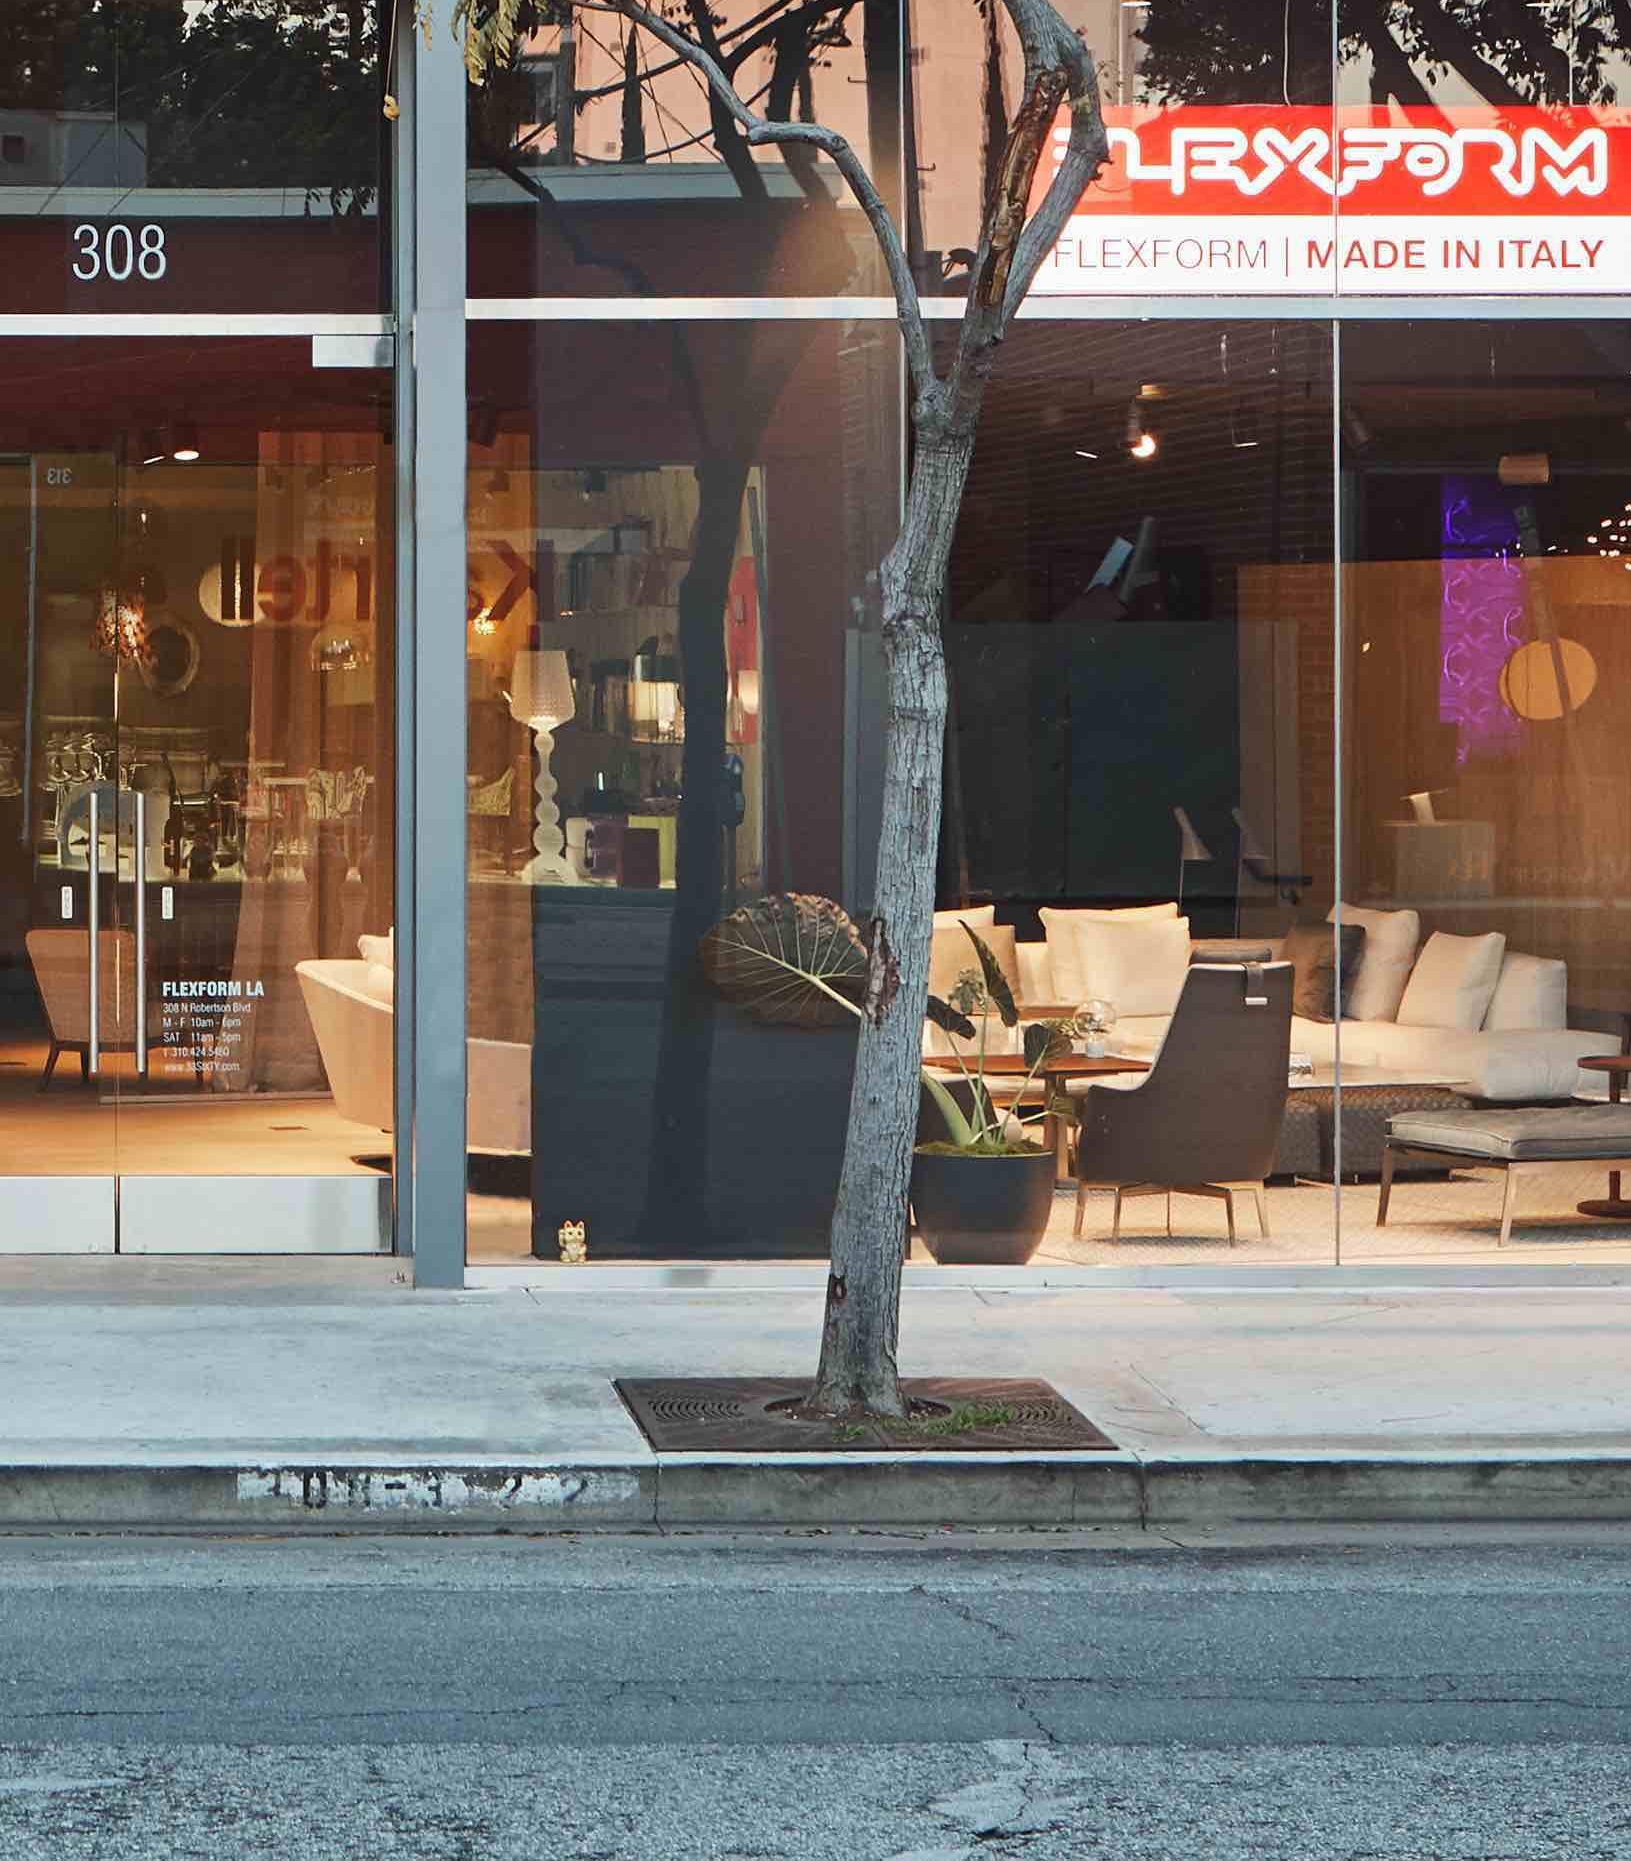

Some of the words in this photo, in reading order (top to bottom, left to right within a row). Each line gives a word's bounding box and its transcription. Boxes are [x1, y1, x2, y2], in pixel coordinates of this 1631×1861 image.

[72, 224, 167, 281] 308
[1053, 238, 1268, 269] FLEXFORM
[1306, 239, 1425, 269] MADE
[1442, 239, 1482, 269] IN
[1497, 239, 1605, 269] ITALY
[162, 981, 241, 996] FLEXFORM
[246, 981, 265, 996] LA
[163, 1002, 179, 1013] 308
[181, 1002, 188, 1013] N
[190, 1002, 232, 1013] Robertson
[233, 1002, 251, 1013] Blvd
[162, 1017, 172, 1028] M
[180, 1017, 185, 1028] F
[163, 1032, 180, 1043] SAT
